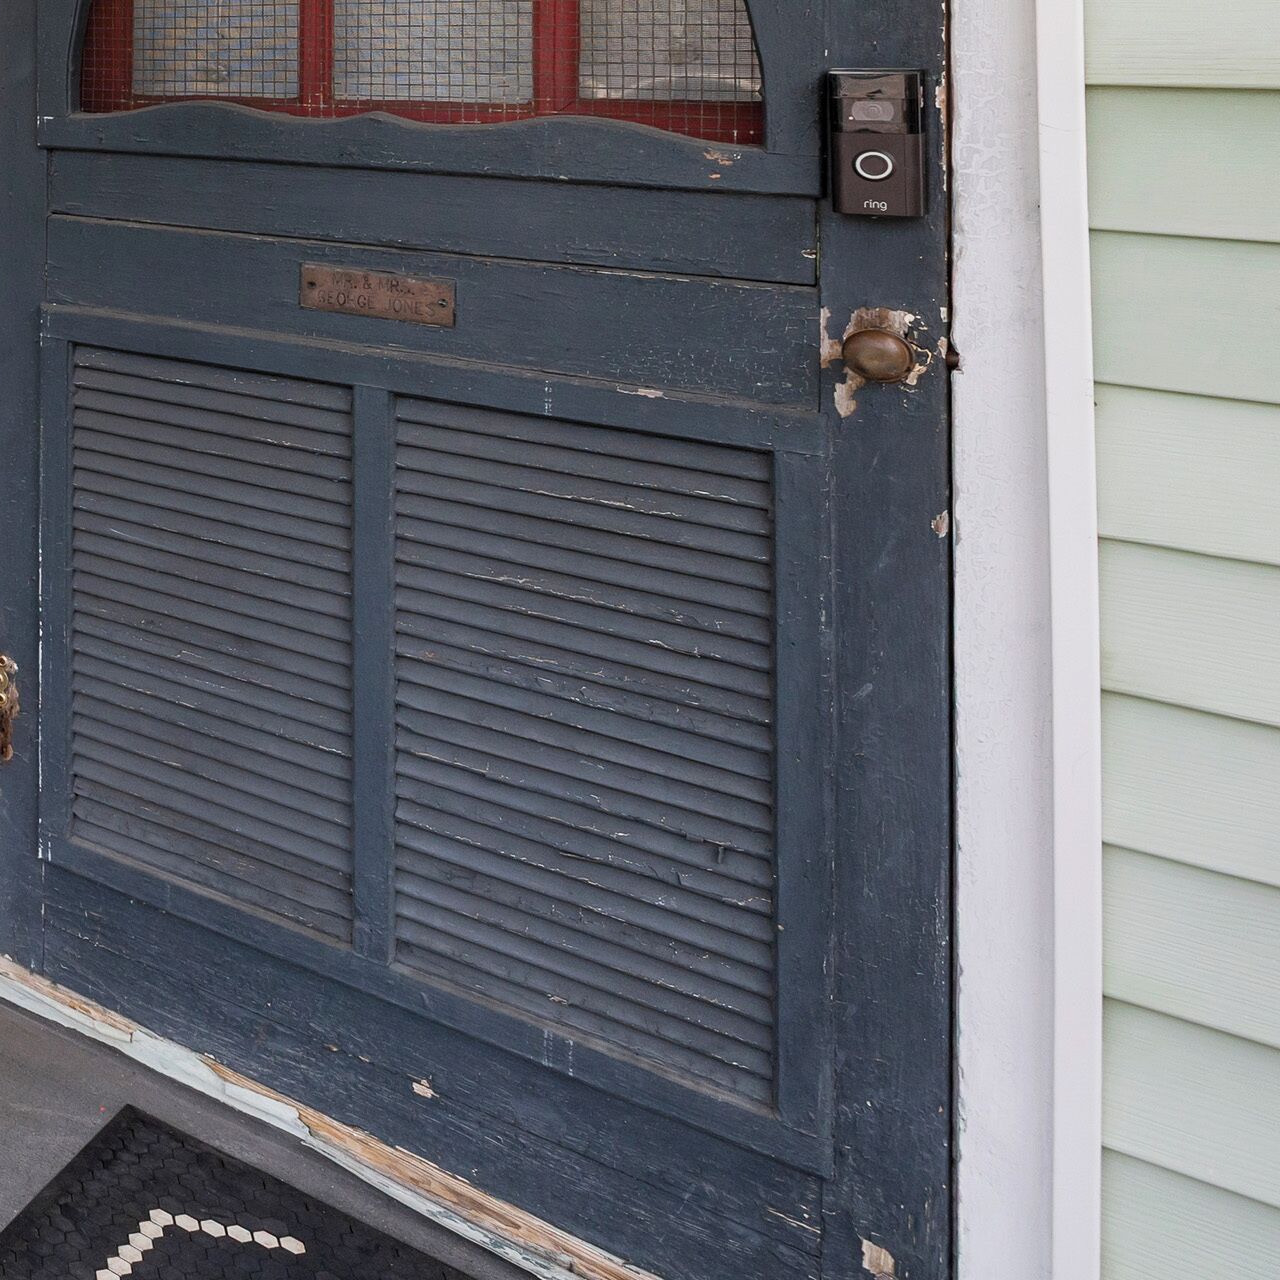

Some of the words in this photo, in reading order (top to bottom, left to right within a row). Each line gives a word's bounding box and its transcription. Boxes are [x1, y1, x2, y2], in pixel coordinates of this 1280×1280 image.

[863, 199, 888, 212] ring
[362, 272, 373, 290] &
[384, 297, 436, 317] JONES
